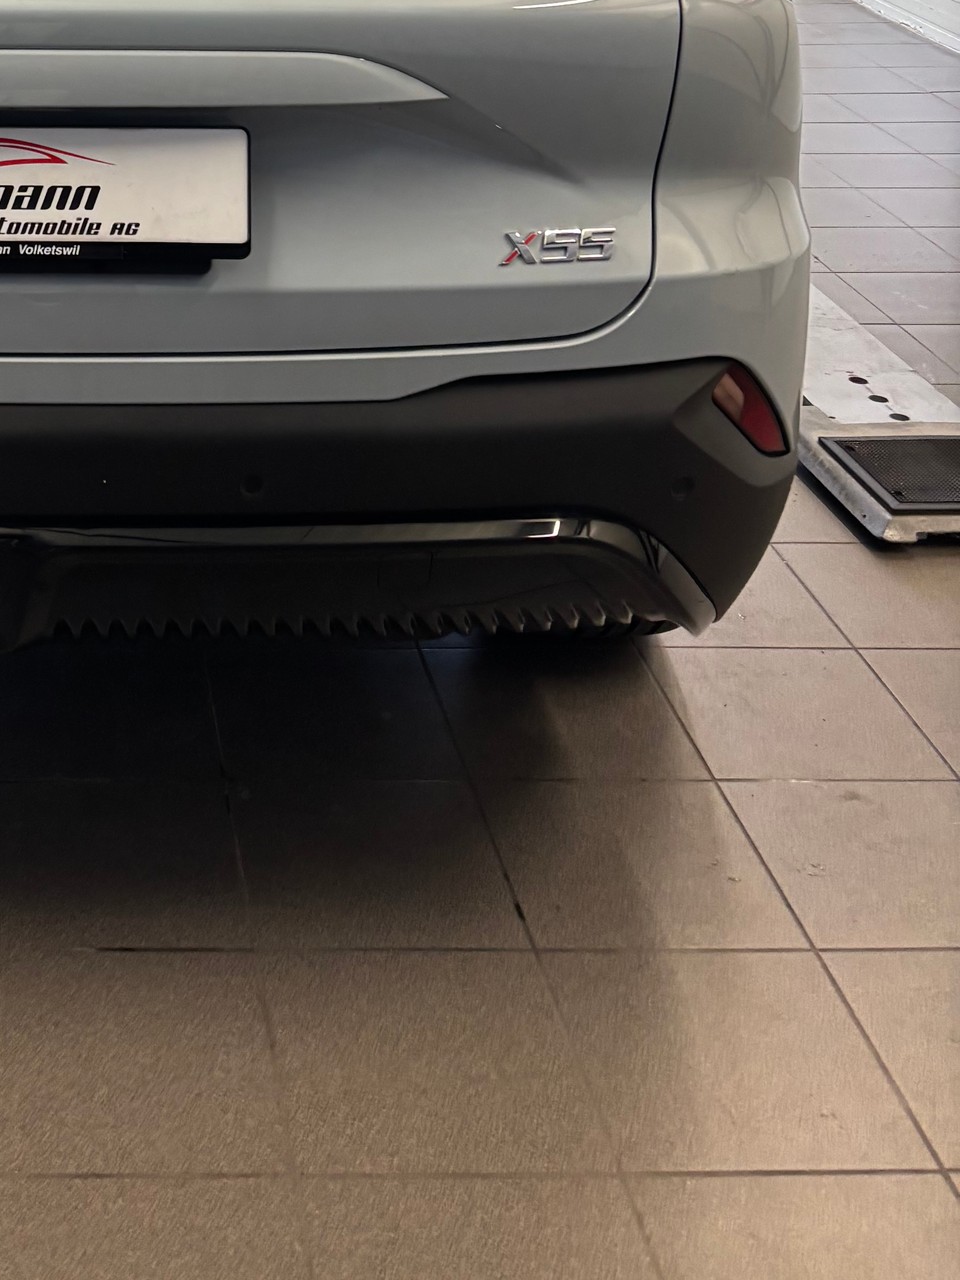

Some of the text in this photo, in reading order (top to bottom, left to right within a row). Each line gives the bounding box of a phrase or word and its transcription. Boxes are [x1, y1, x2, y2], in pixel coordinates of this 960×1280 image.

[109, 222, 141, 236] AG
[18, 244, 81, 256] Volketswil
[498, 226, 617, 266] X55
